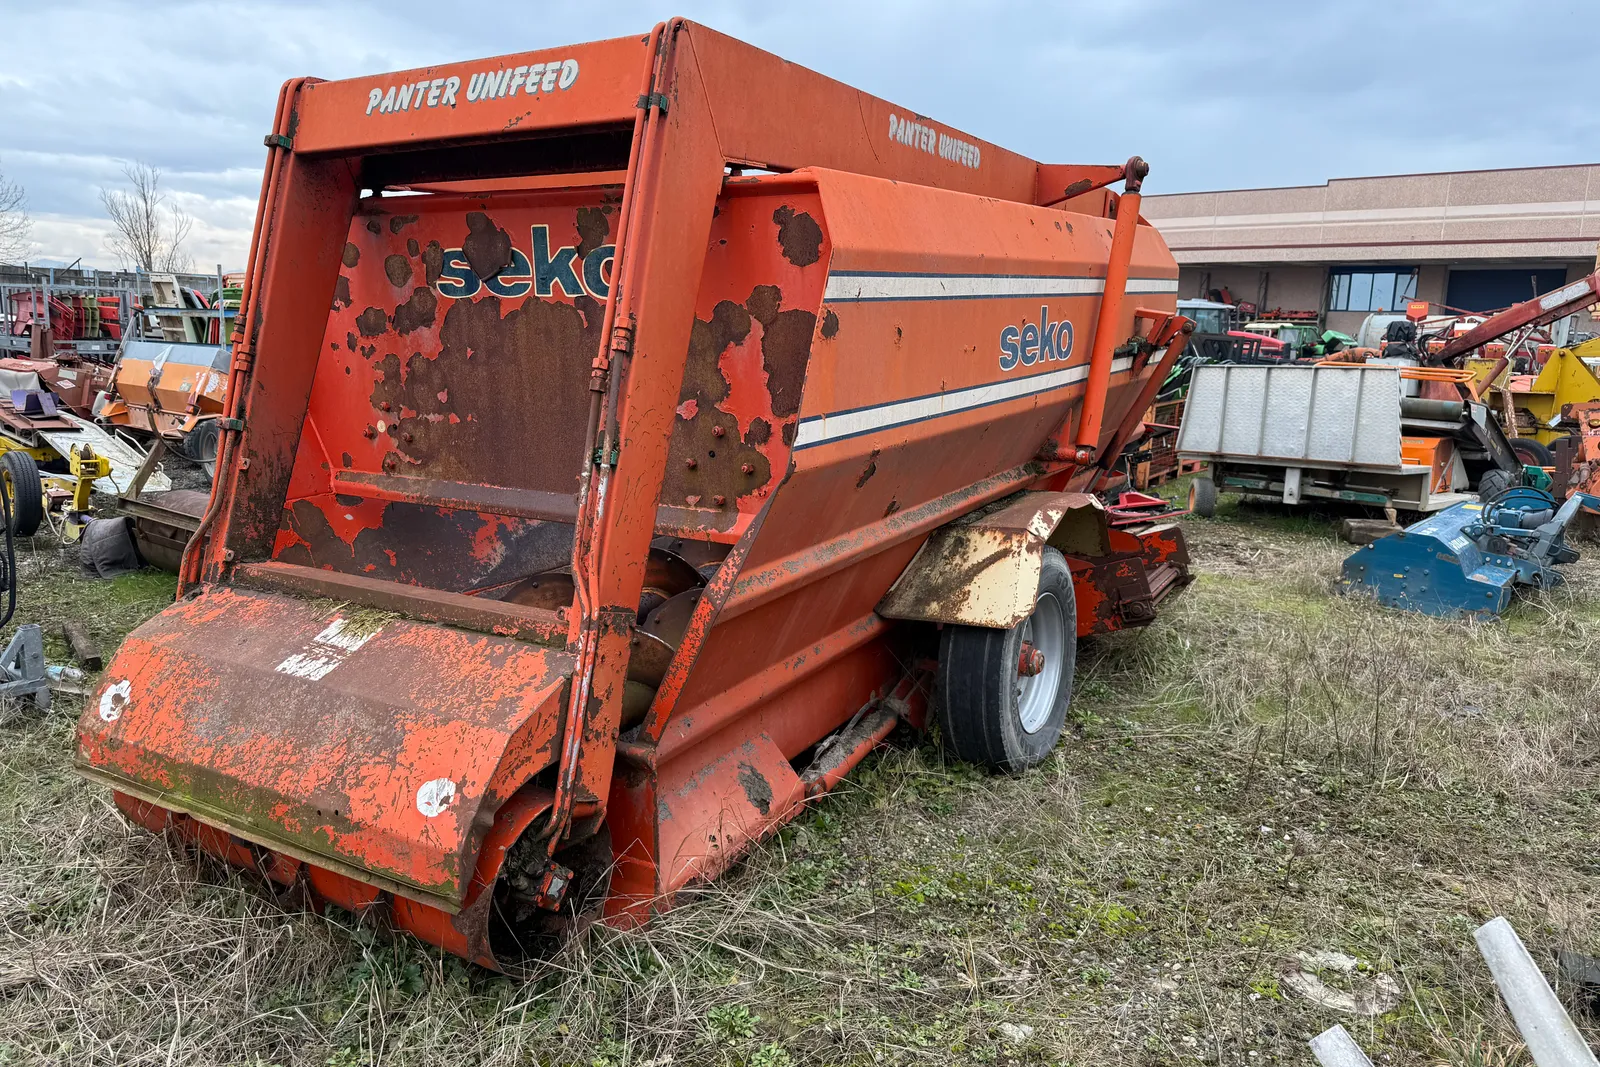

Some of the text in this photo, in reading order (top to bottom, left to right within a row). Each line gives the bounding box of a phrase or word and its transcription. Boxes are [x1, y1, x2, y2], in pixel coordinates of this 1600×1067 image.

[366, 58, 579, 116] PANTER UNIFEED
[888, 113, 981, 169] PANTER UNIFEED
[998, 304, 1074, 372] seko
